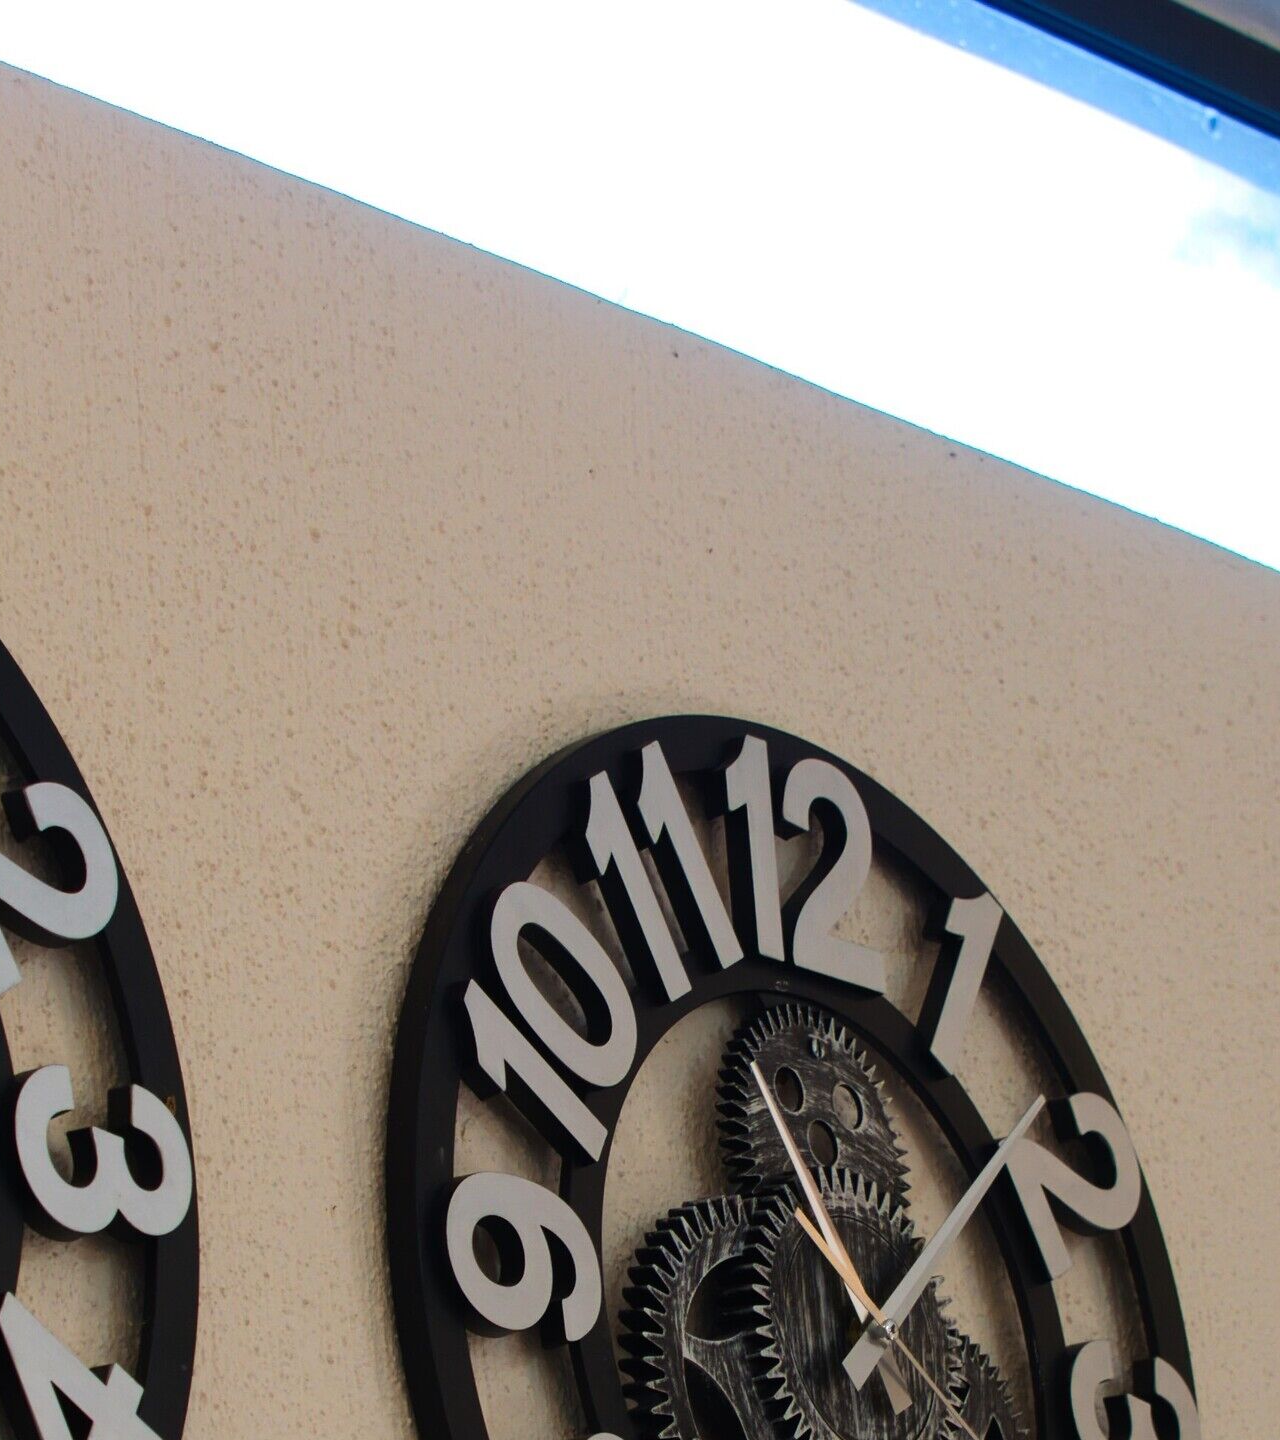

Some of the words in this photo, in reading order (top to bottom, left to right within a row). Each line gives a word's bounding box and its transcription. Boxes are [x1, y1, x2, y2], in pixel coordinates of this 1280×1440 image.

[584, 740, 744, 1001] 11
[725, 734, 885, 994] 12
[464, 880, 636, 1162] 10
[928, 893, 1003, 1076] 1
[15, 1064, 191, 1237] 3
[1000, 1091, 1139, 1278] 2
[446, 1172, 601, 1343] 9
